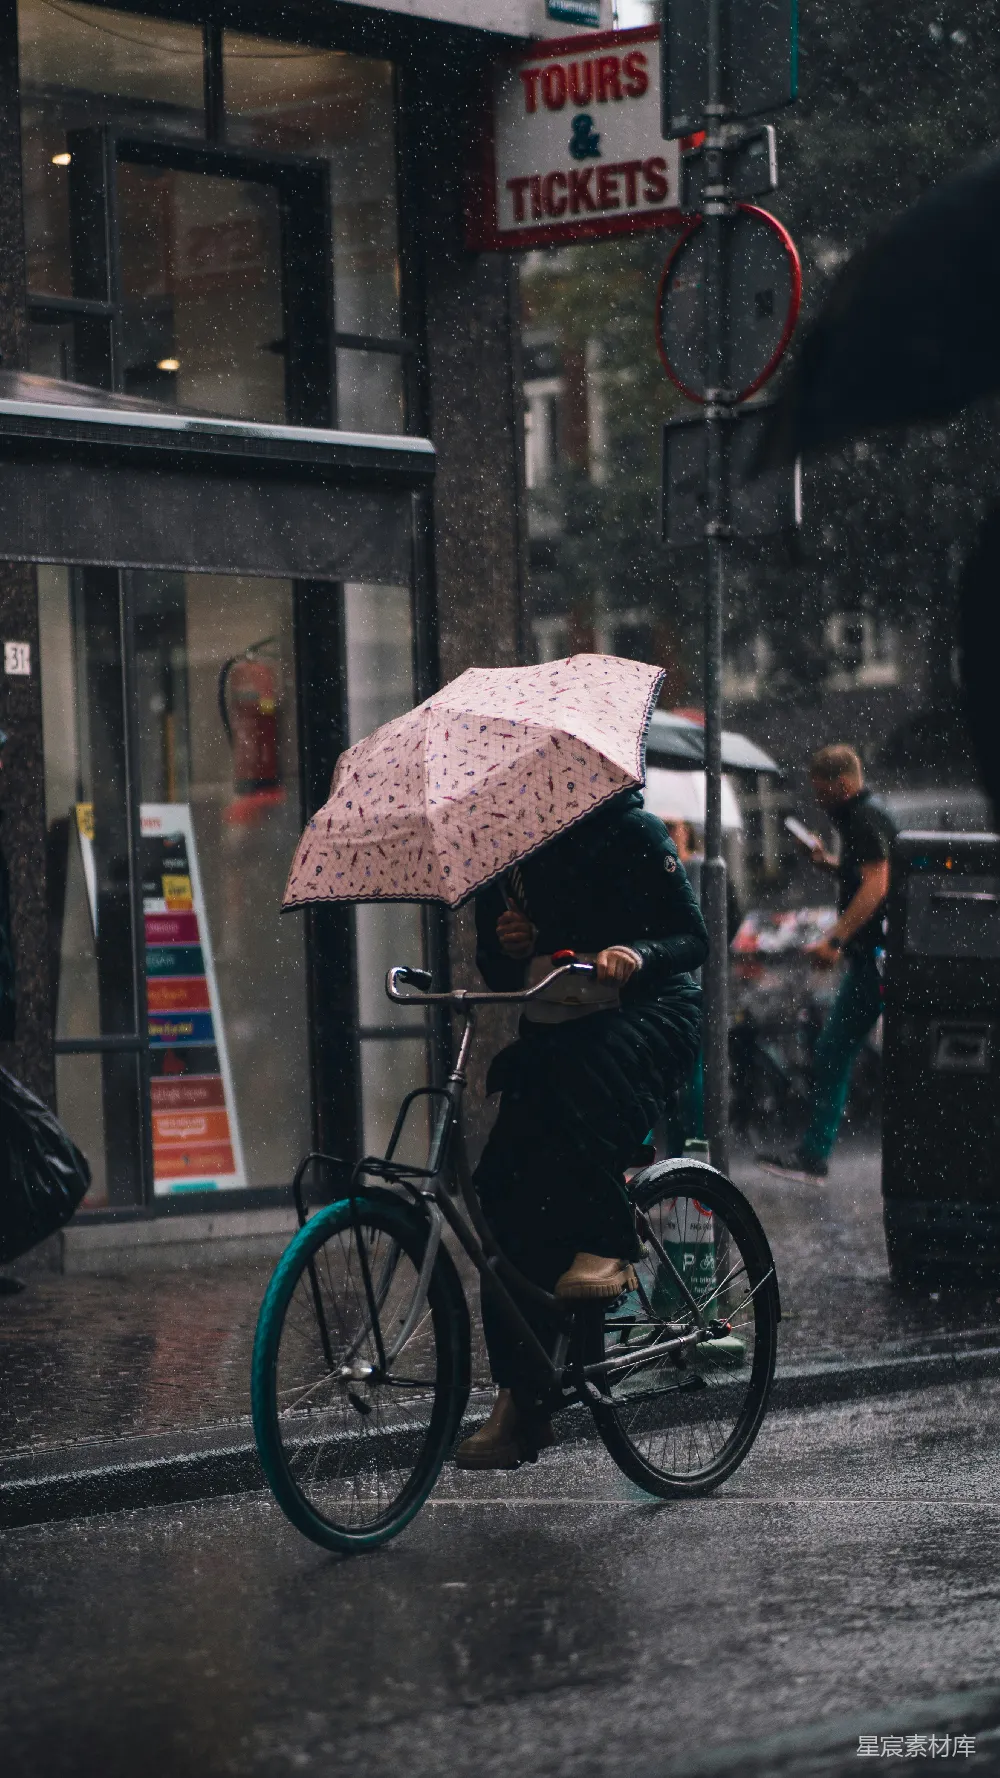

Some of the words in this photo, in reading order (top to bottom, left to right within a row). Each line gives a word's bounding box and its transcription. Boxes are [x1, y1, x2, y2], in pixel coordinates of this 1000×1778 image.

[518, 50, 649, 114] TOURS
[569, 113, 601, 161] &
[505, 156, 669, 222] TICKETS
[9, 647, 24, 671] 31
[682, 1252, 695, 1272] P
